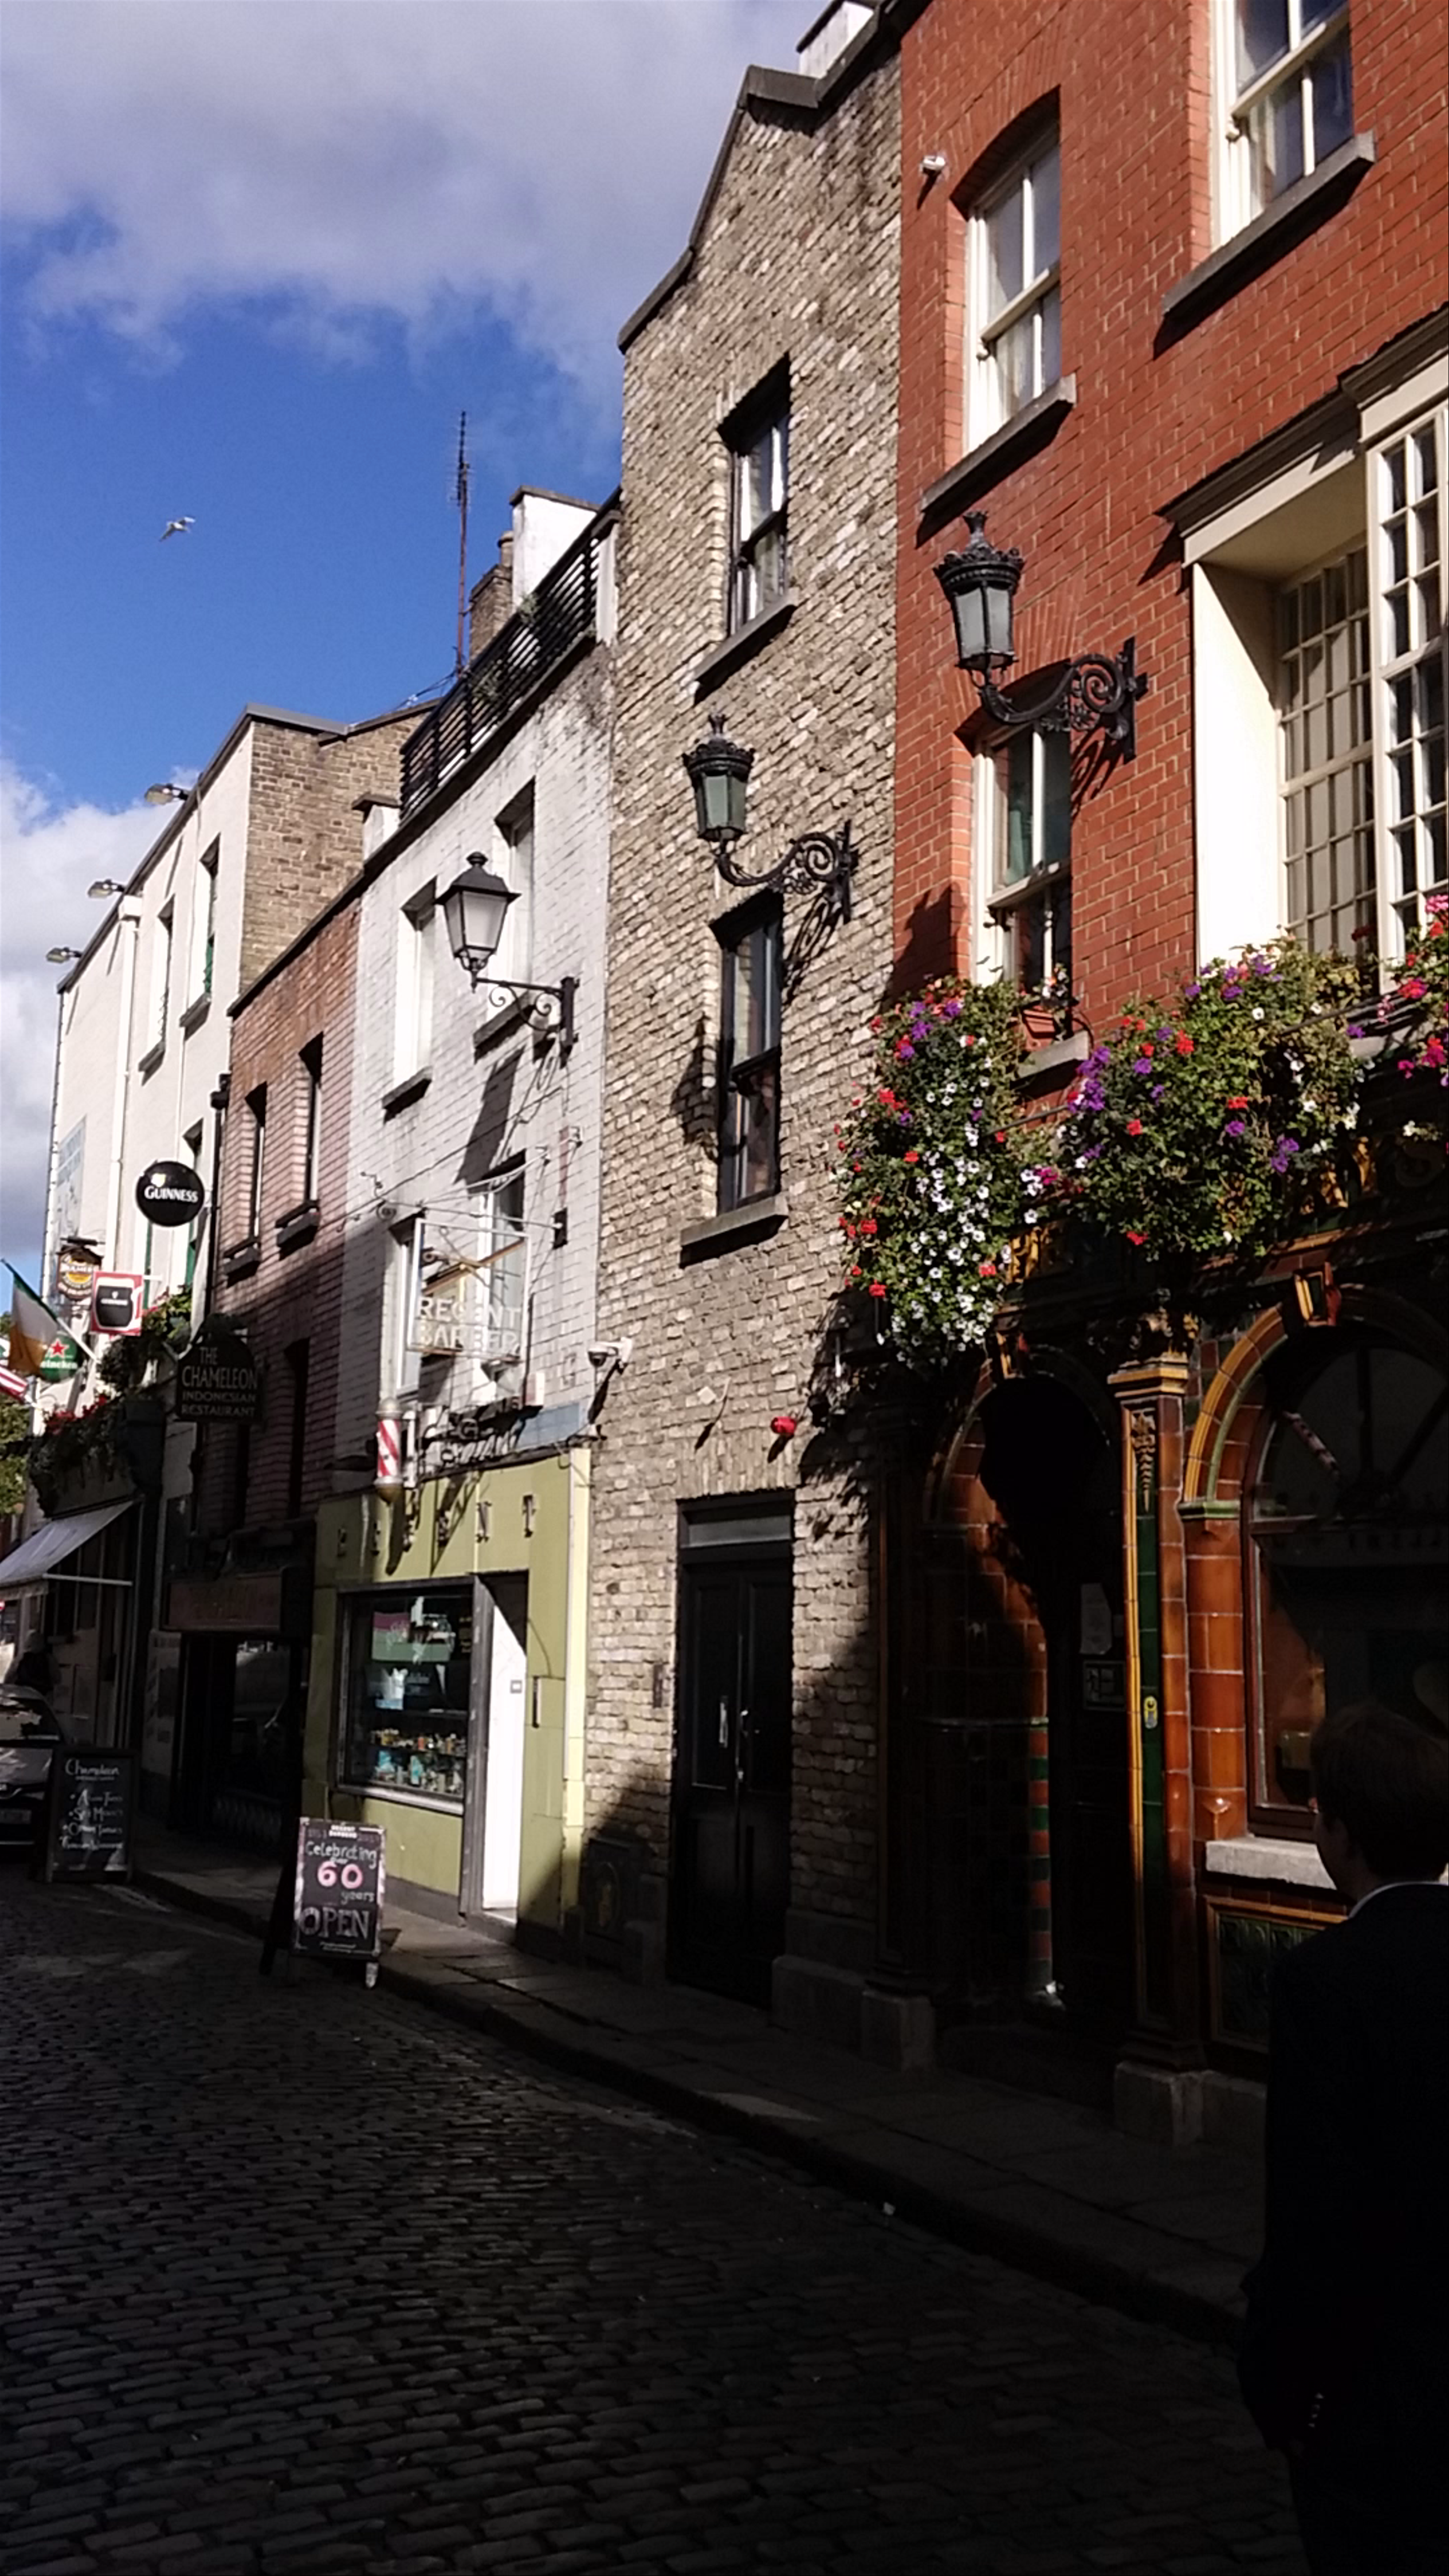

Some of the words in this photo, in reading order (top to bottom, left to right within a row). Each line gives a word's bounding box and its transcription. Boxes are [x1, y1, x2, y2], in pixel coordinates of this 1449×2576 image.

[420, 1297, 521, 1329] REGENT
[200, 1346, 218, 1365] THE
[182, 1365, 257, 1390] CHAMELEON
[181, 1404, 255, 1415] RESTAURANT
[183, 1391, 257, 1403] INDONESIAN
[305, 1841, 377, 1870] Celebrating
[317, 1861, 363, 1889] 60
[341, 1890, 374, 1905] years
[300, 1907, 370, 1940] OPEN
